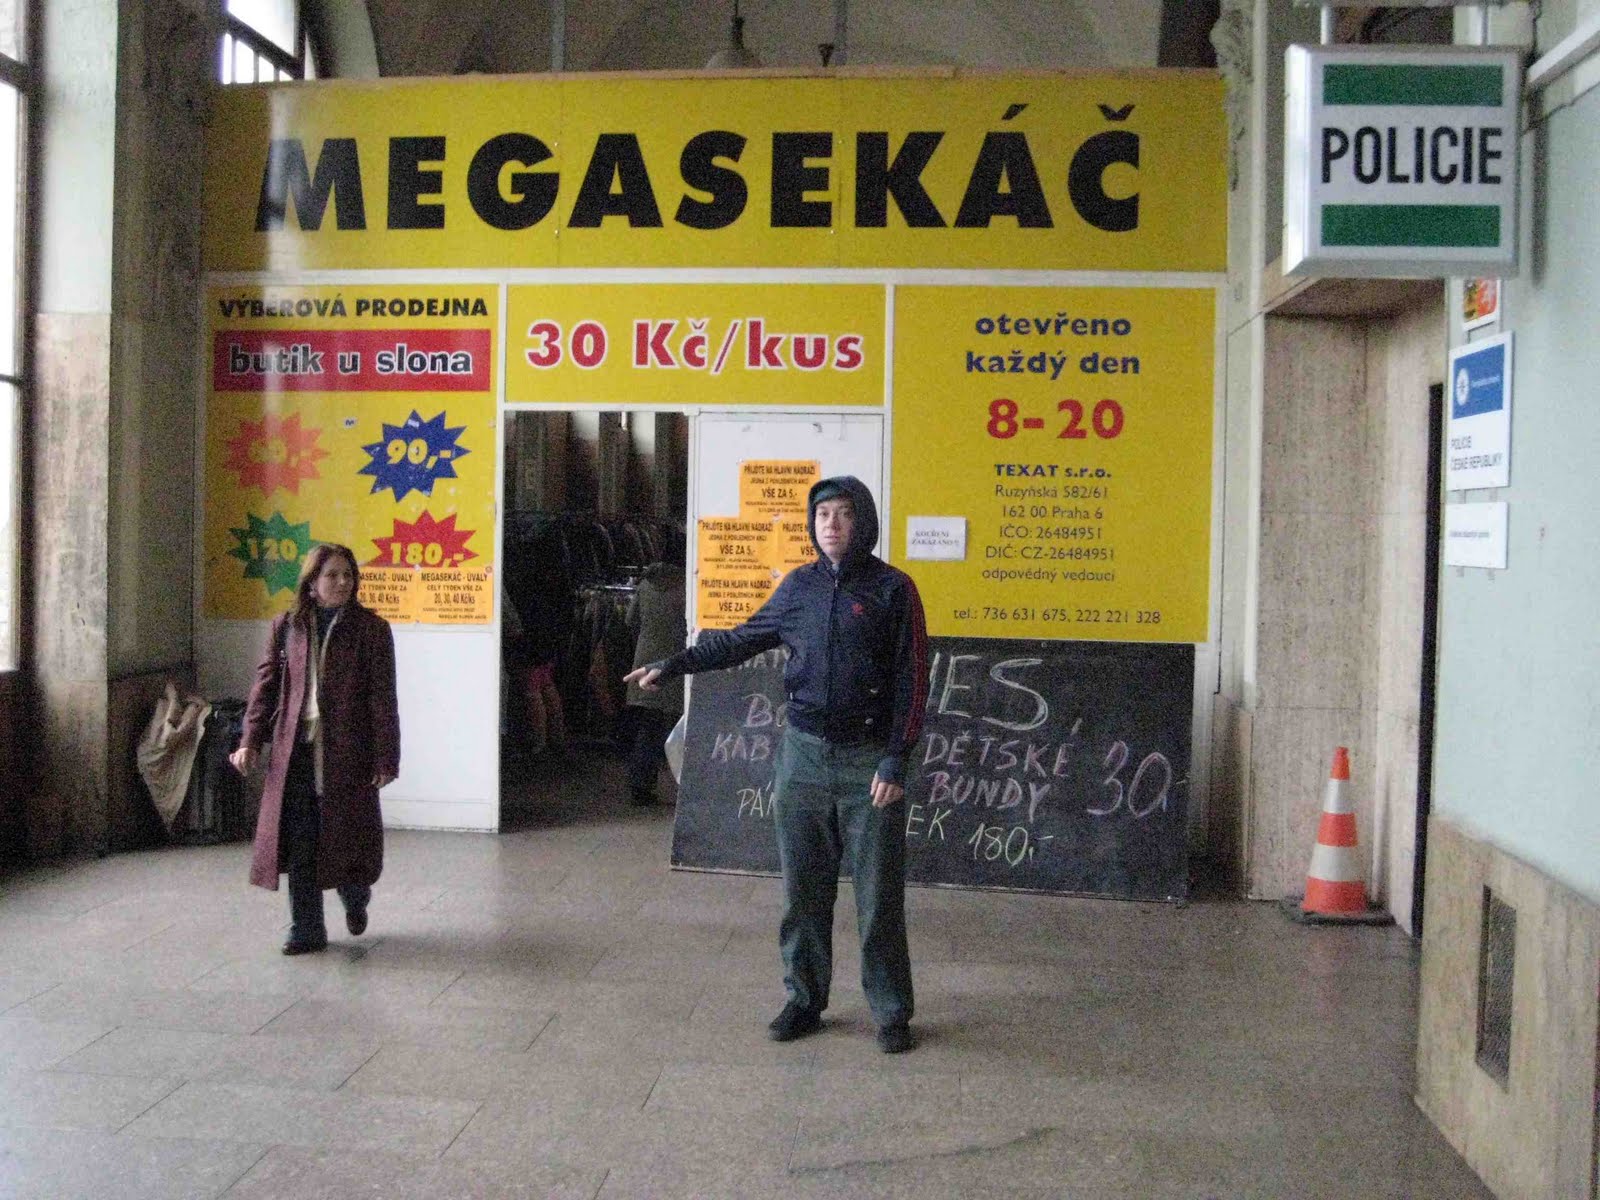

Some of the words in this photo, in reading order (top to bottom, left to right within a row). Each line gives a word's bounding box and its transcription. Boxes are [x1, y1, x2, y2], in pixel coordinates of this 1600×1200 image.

[1321, 126, 1503, 185] POLICIE
[255, 103, 1140, 233] MEGASEKÁČ
[356, 298, 488, 317] PRODEJNA
[975, 313, 1132, 337] otevřeno
[526, 319, 608, 369] 30
[633, 315, 865, 375] Kč/kus
[229, 343, 324, 375] butik
[338, 353, 360, 375] u
[376, 343, 472, 375] slona
[965, 350, 1068, 381] každý
[1080, 351, 1141, 375] den
[386, 438, 452, 470] 90,-
[994, 464, 1058, 477] TEXAT
[1065, 467, 1112, 478] s.r.o.
[778, 488, 787, 498] ZA
[1063, 486, 1108, 498] 582/61
[1003, 505, 1025, 518] 162
[1030, 505, 1047, 518] 00
[1053, 506, 1090, 519] Praha
[1095, 507, 1103, 519] 6
[1000, 524, 1033, 539] IČO:
[1036, 527, 1102, 539] 26484951
[736, 545, 745, 555] ZA
[986, 544, 1017, 559] DIČ:
[735, 602, 744, 611] ZA
[983, 607, 1008, 620] 736
[1012, 608, 1035, 620] 631
[1076, 609, 1100, 622] 222
[1106, 610, 1128, 623] 221
[1136, 611, 1161, 624] 328
[927, 770, 1050, 824] BUNDY
